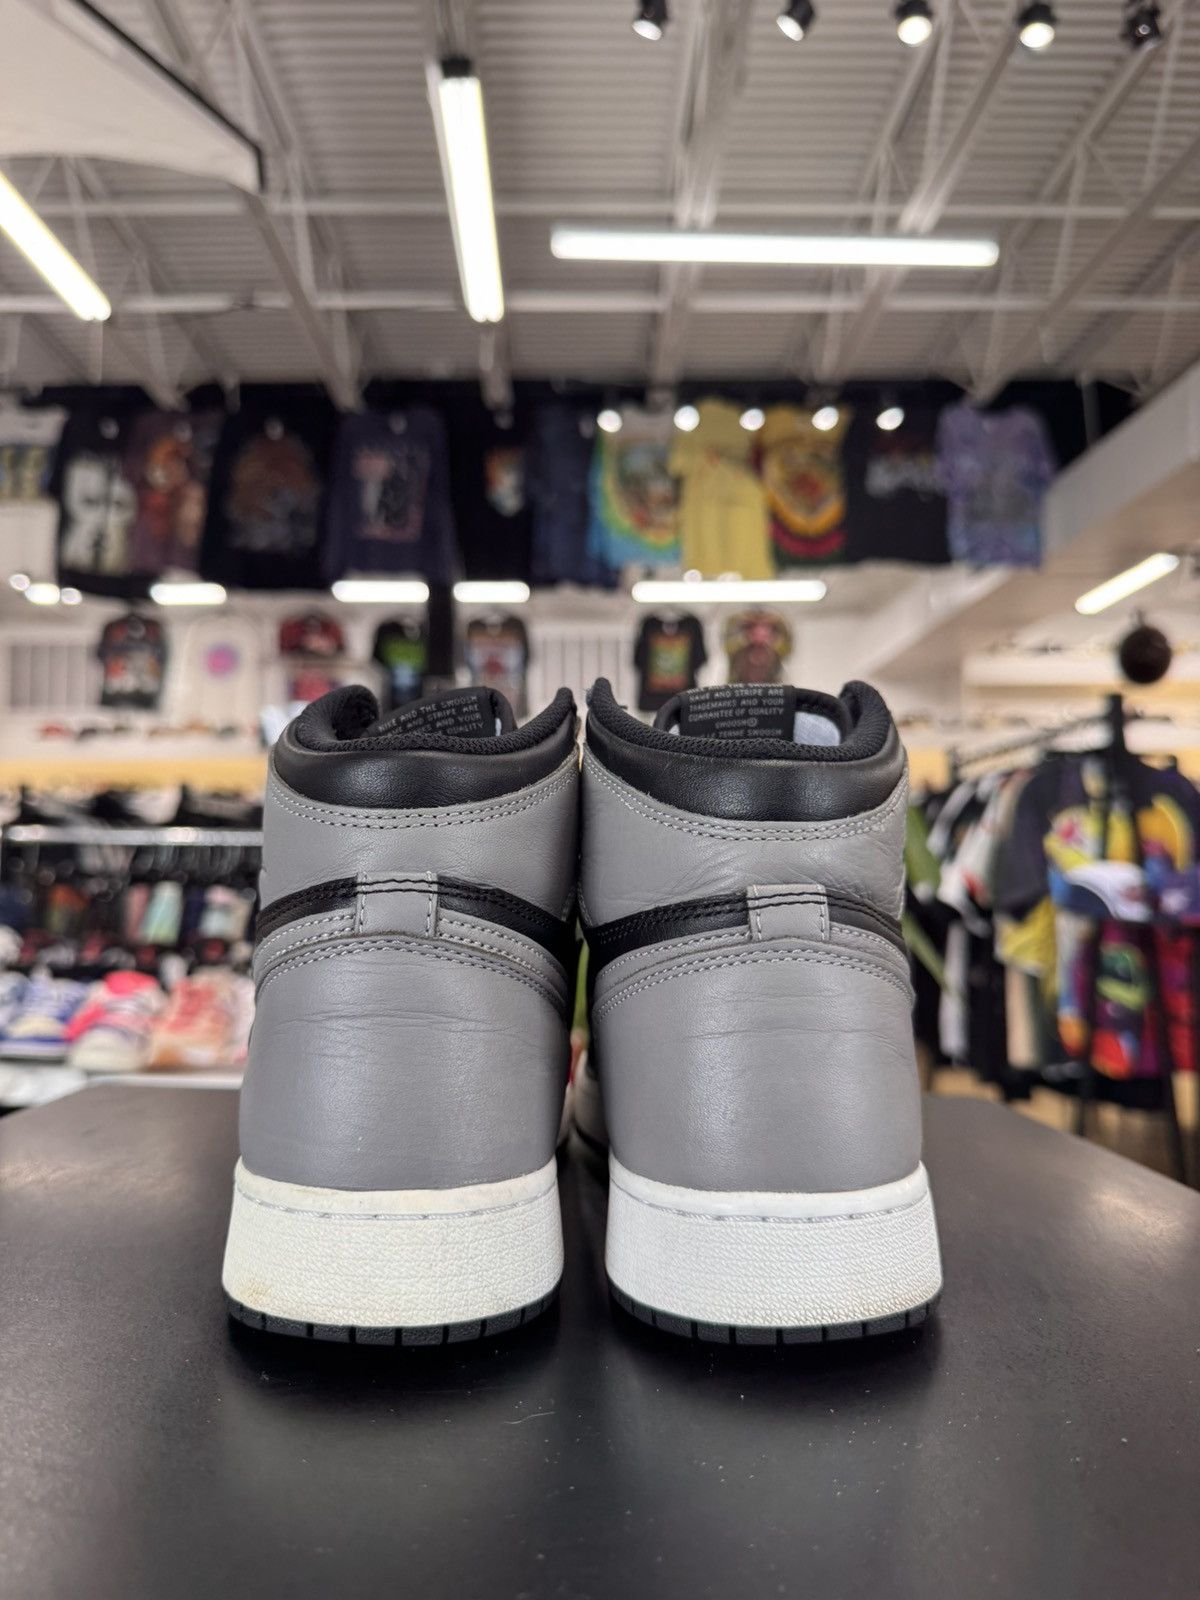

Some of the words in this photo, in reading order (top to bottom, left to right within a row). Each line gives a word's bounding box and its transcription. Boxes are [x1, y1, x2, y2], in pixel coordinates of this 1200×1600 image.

[689, 692, 710, 702] NAME
[714, 690, 731, 699] AND
[735, 689, 762, 697] STRIPE
[768, 688, 784, 697] ARE
[689, 698, 737, 711] TRADEMARKS
[740, 698, 758, 706] AND
[762, 698, 784, 706] YOUR
[378, 718, 397, 732] NIKE
[400, 710, 418, 723] AND
[420, 703, 437, 714] THE
[441, 695, 477, 708] SWOOSH
[407, 717, 424, 729] AND
[427, 708, 456, 722] STRIPE
[463, 704, 479, 714] ARE
[436, 717, 455, 728] AND
[458, 712, 482, 722] YOUR
[688, 709, 733, 722] GUARANTEE
[735, 708, 745, 716] OF
[748, 707, 784, 716] QUALITY
[447, 721, 484, 735] QUALITY
[747, 728, 782, 737] SWOOSH
